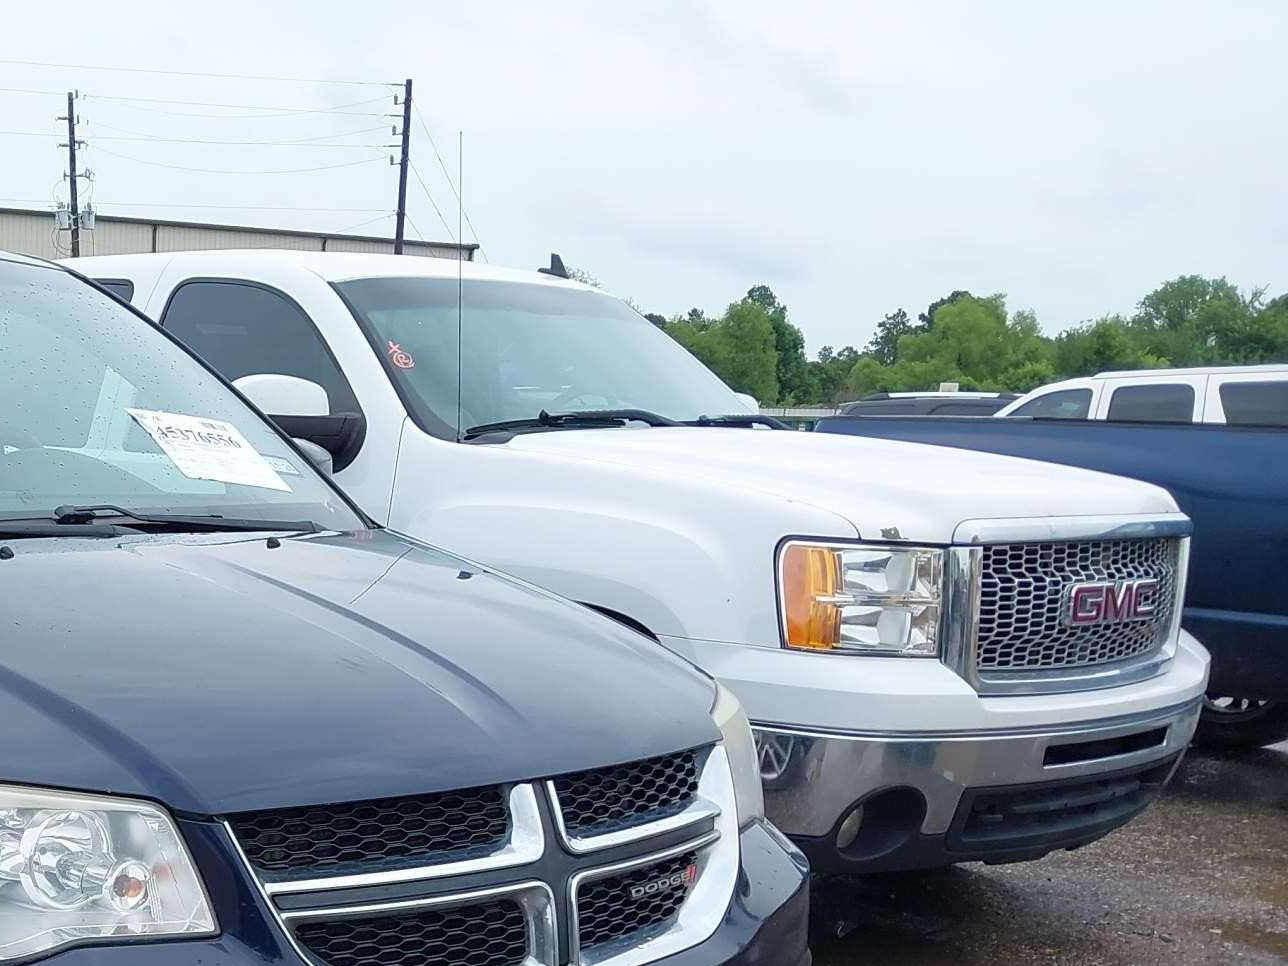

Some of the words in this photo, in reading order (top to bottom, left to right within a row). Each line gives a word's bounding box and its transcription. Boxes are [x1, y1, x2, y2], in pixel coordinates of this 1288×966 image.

[156, 426, 242, 449] 45376556
[1071, 579, 1157, 626] GMC
[631, 872, 689, 898] DODGE
